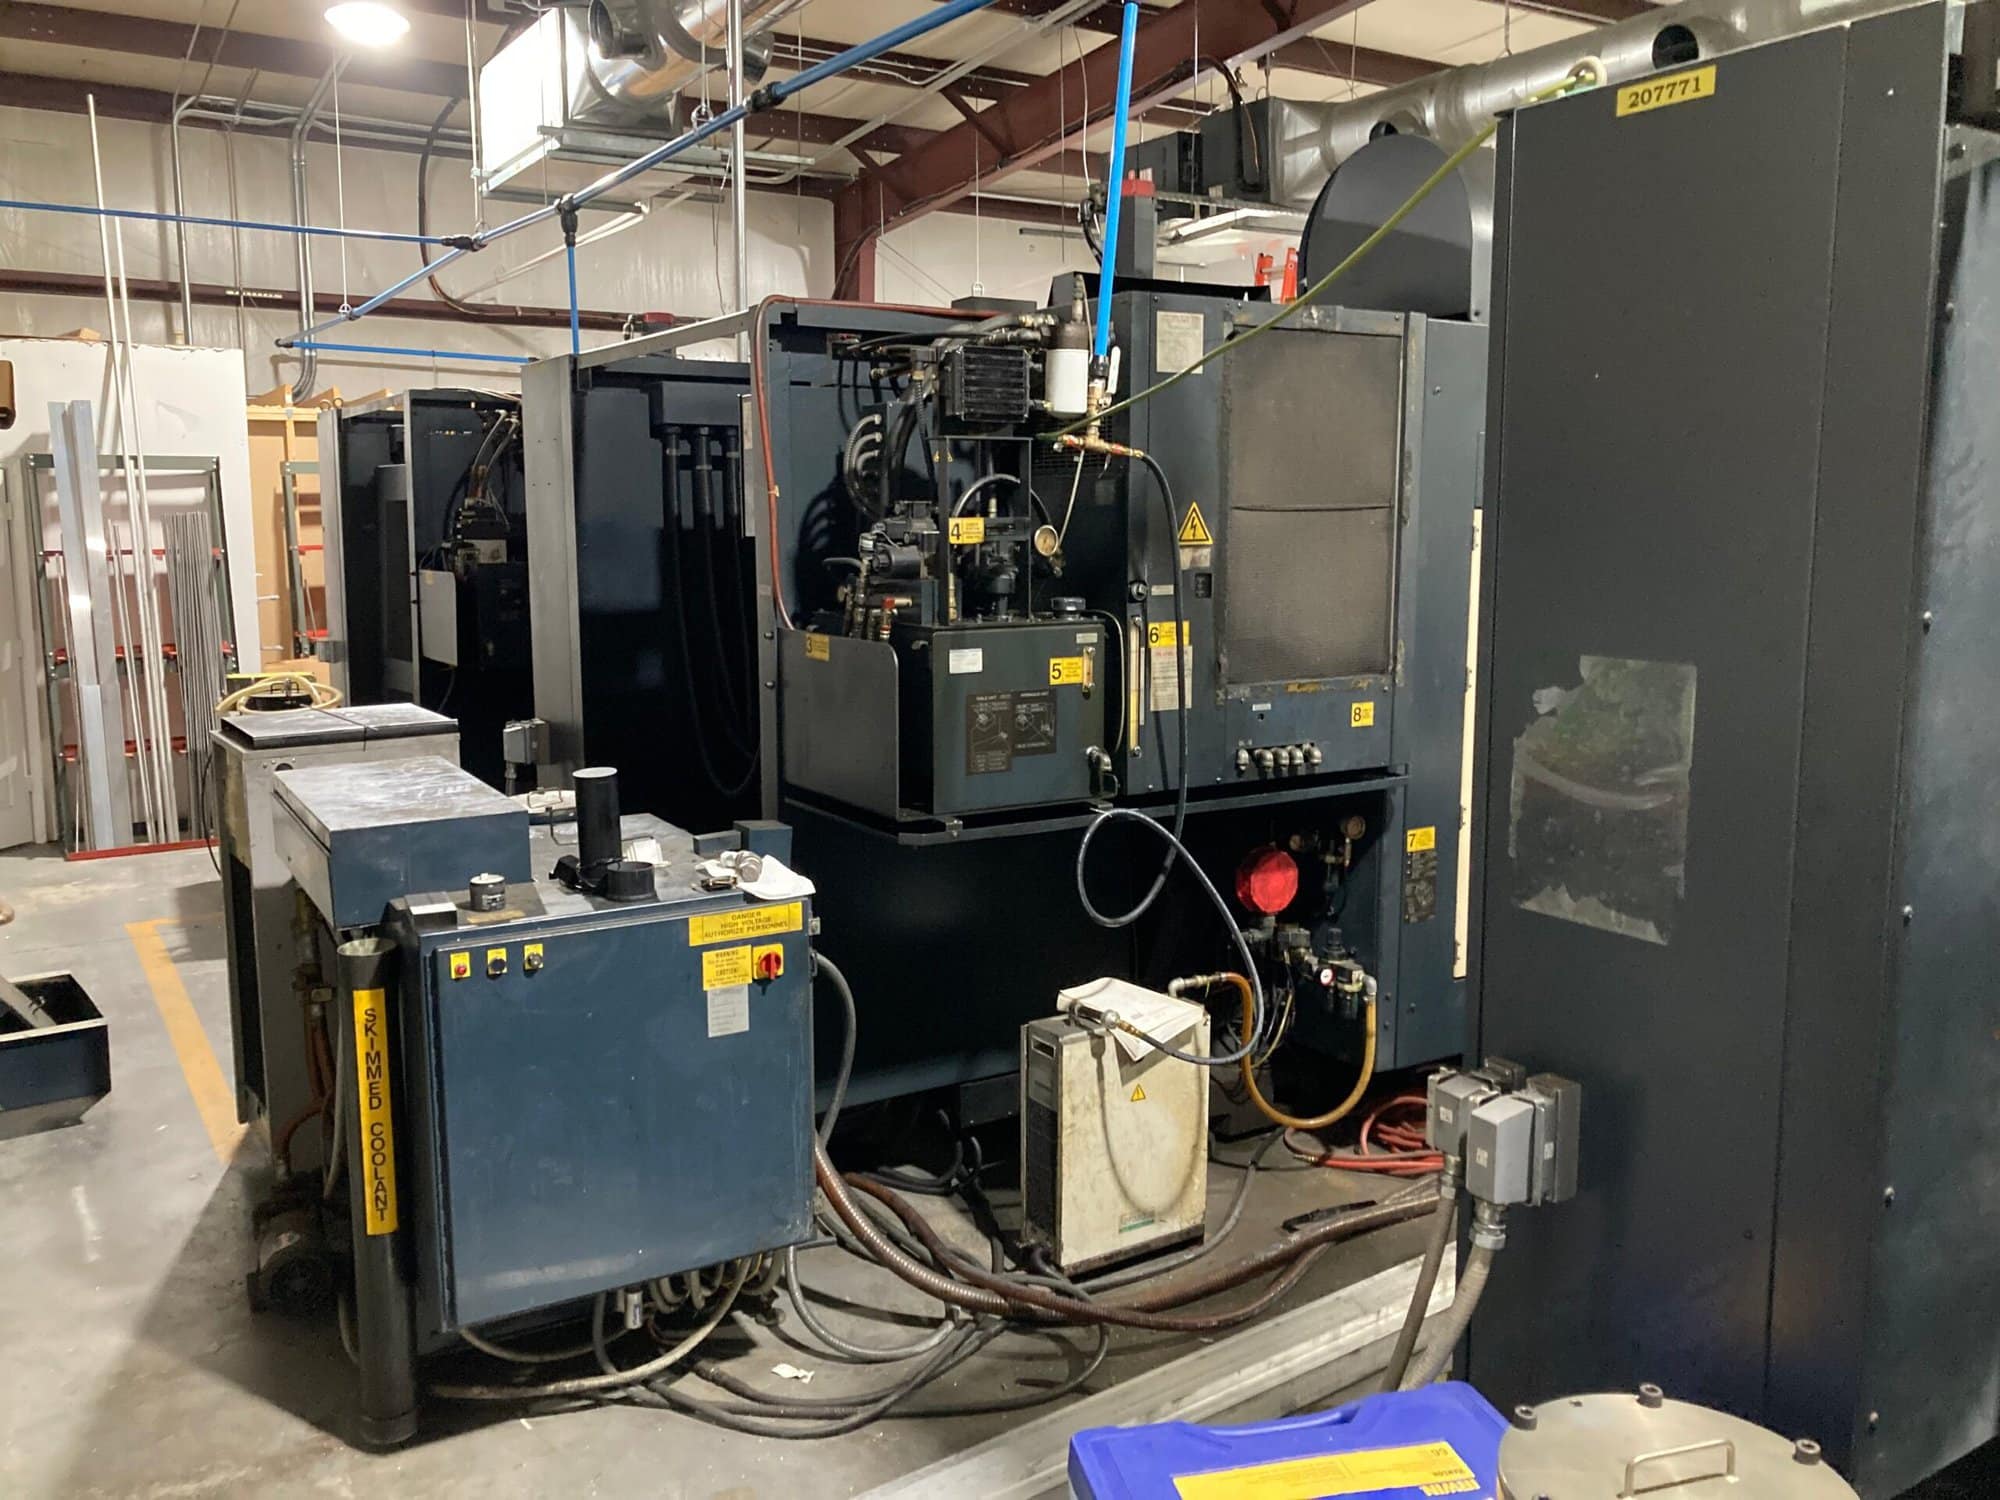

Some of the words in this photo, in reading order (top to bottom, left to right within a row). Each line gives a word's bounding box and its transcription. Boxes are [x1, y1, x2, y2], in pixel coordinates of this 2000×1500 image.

[1627, 76, 1701, 109] 207771
[951, 523, 961, 541] 4
[1149, 626, 1159, 643] 6
[1051, 662, 1062, 680] 5
[1353, 706, 1361, 722] 8
[1408, 833, 1416, 848] 7
[720, 920, 739, 929] HIGH
[741, 916, 772, 926] VOLTAGE
[731, 911, 762, 921] DANGER
[704, 928, 744, 938] AUTHORIZE
[746, 920, 789, 933] PERSONNEL
[364, 1007, 382, 1110] SKIMMED
[370, 1122, 388, 1222] COOLANT
